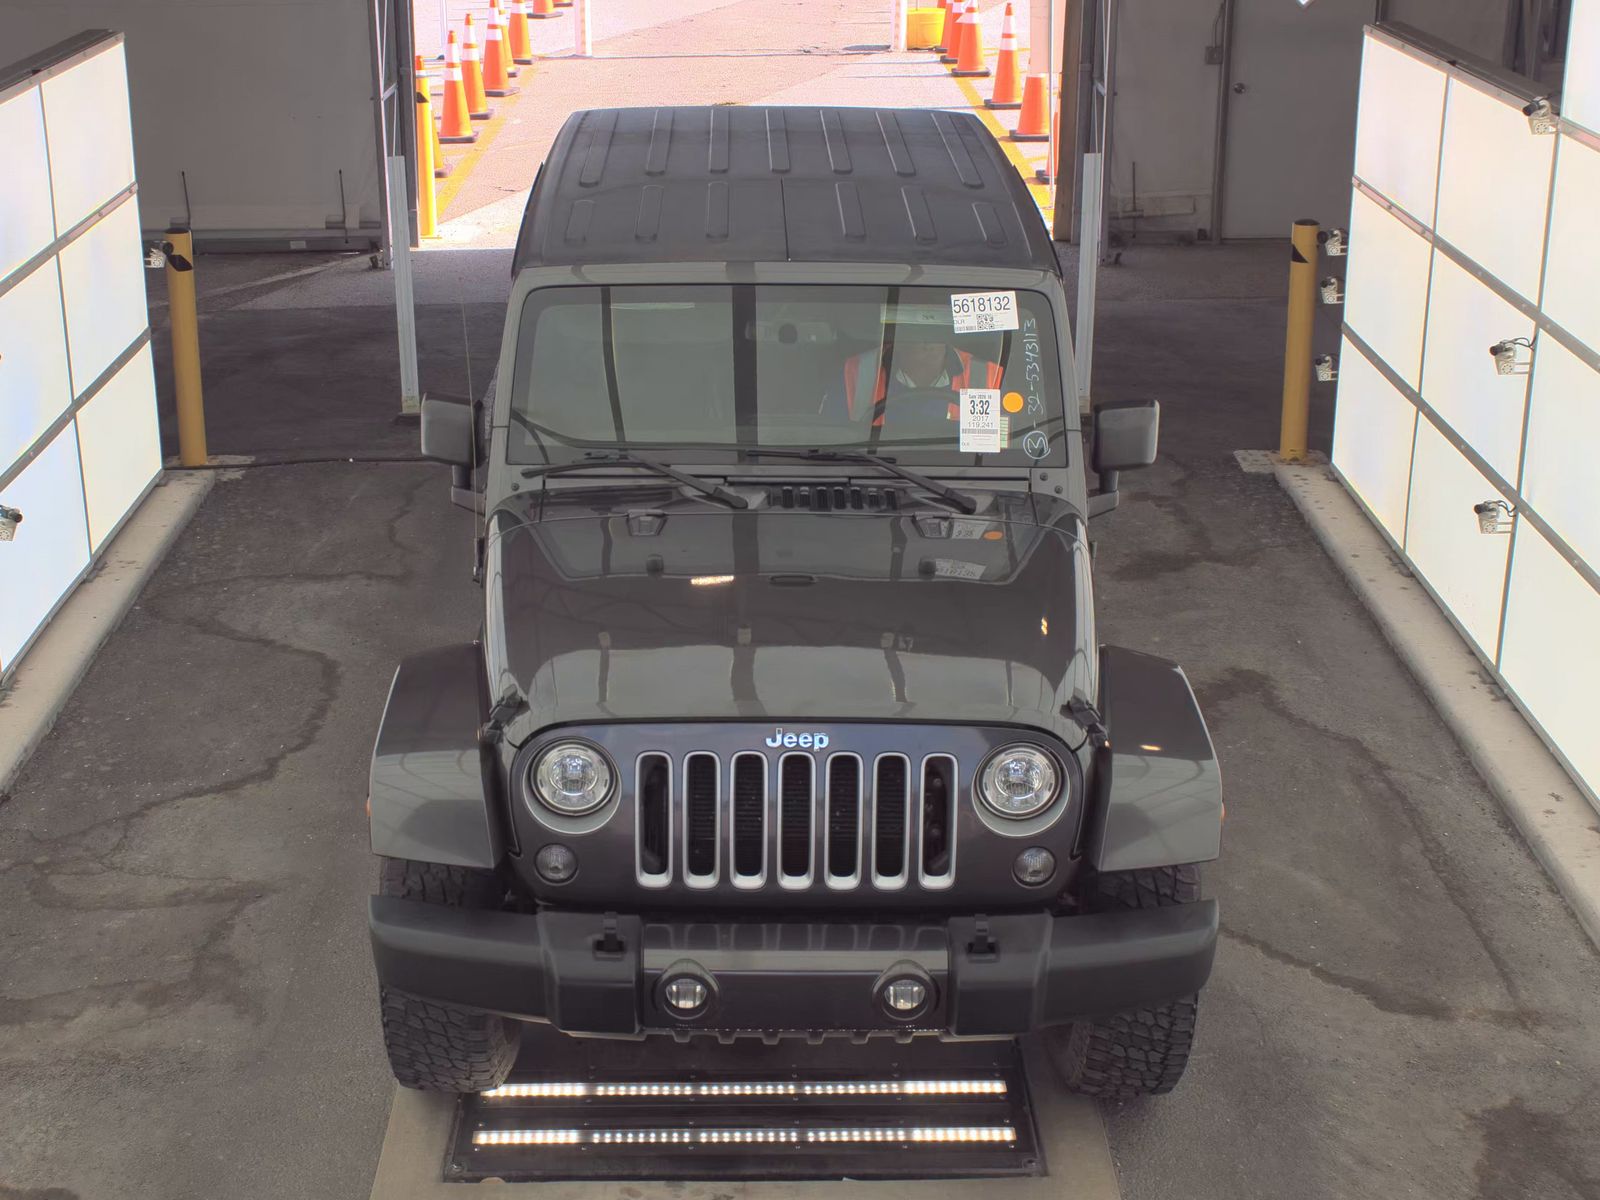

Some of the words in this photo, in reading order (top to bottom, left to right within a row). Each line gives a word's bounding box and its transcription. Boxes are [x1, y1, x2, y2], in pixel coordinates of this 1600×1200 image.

[953, 296, 1011, 314] 5618132
[969, 400, 990, 415] 3:32
[765, 727, 829, 752] Jeep
